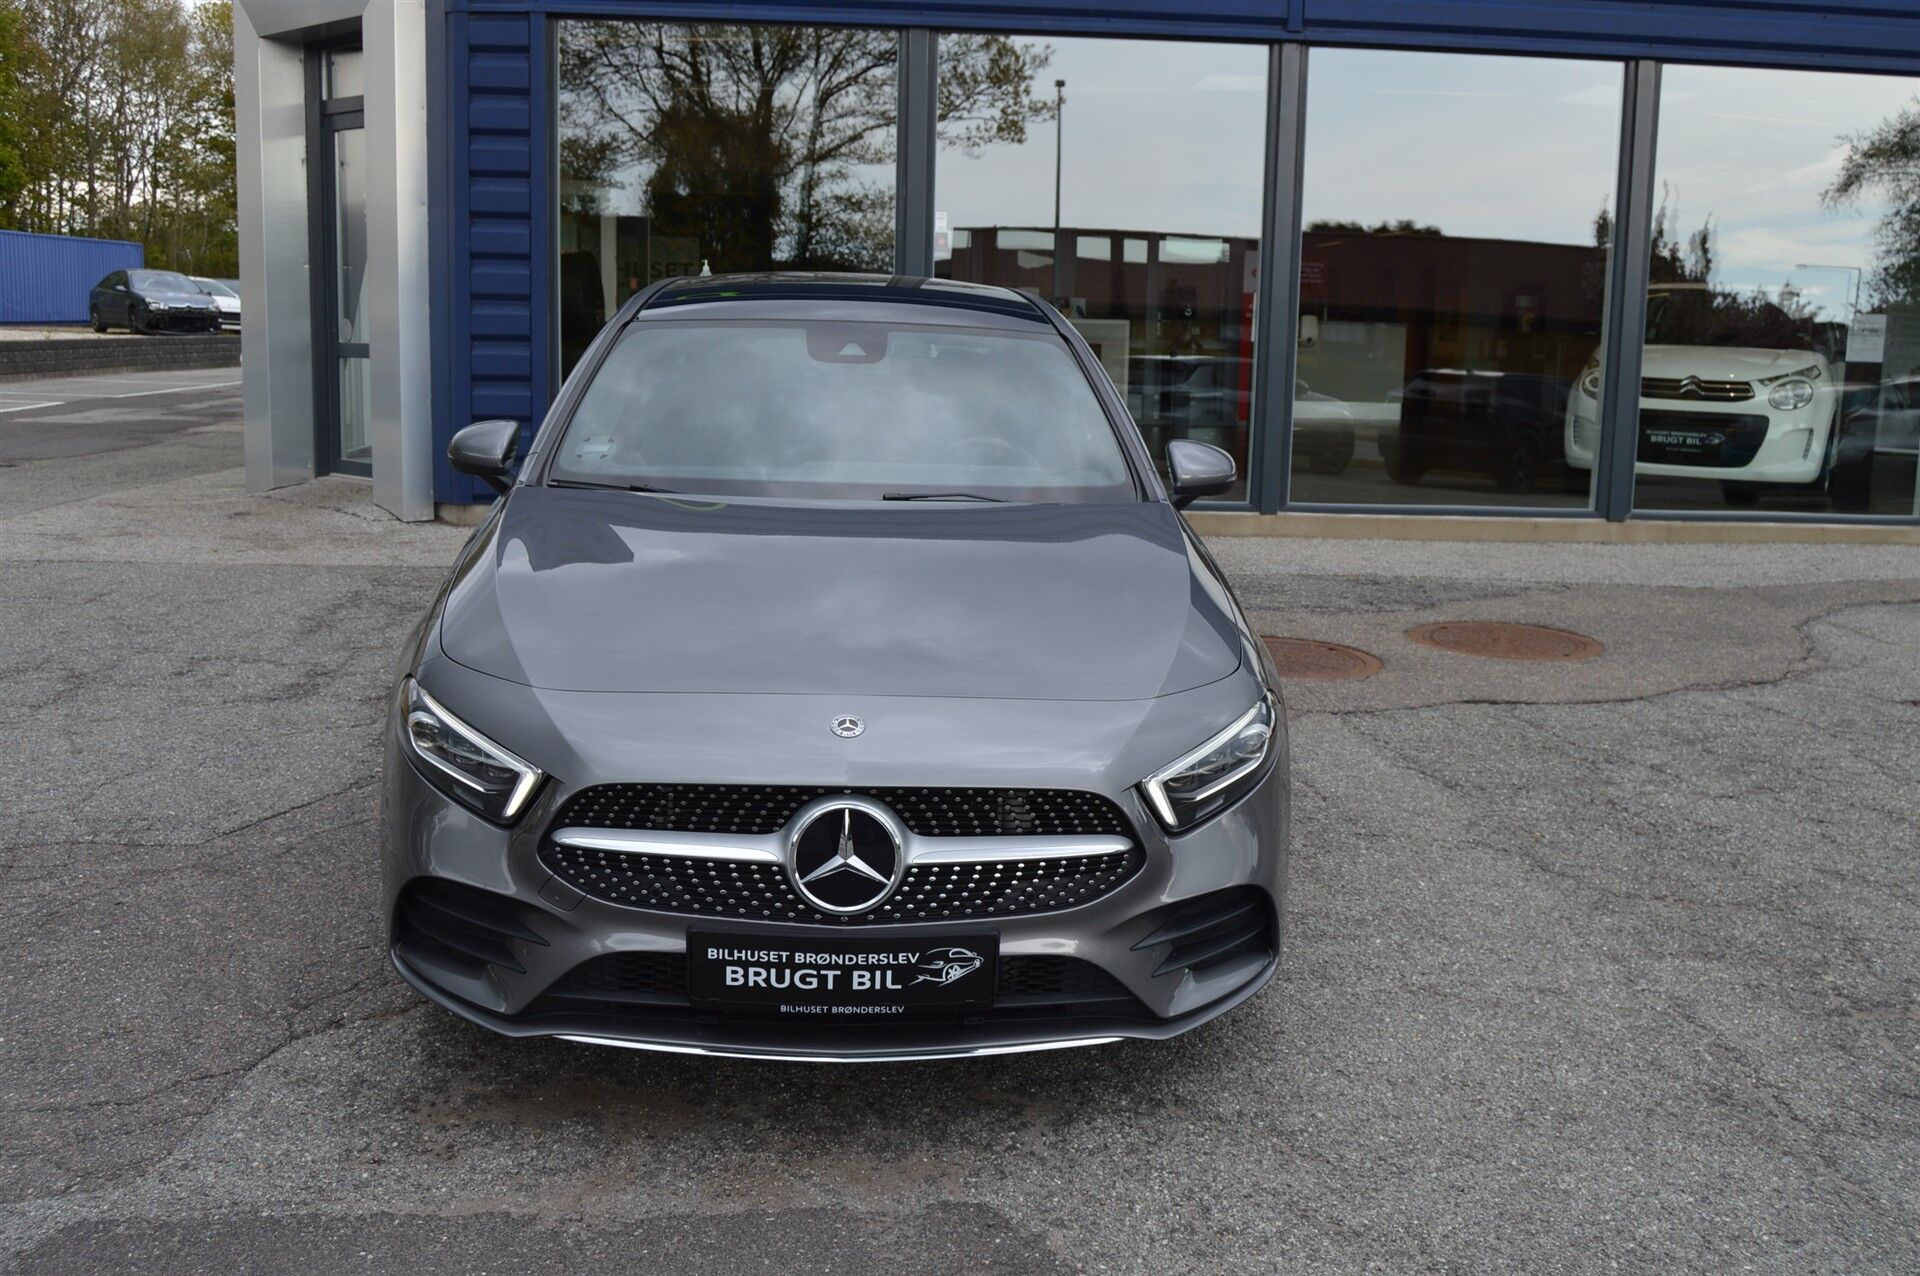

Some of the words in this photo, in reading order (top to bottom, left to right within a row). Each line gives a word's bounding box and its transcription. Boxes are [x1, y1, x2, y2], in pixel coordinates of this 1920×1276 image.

[1650, 435, 1684, 444] BRUGT
[1686, 437, 1702, 445] BIL
[707, 948, 790, 963] BILHUSET
[794, 952, 920, 965] BRØNDERSLEV
[725, 965, 841, 990] BRUGT
[852, 970, 902, 990] BIL
[780, 1004, 828, 1014] BILHUSET
[831, 1005, 905, 1014] BRØNDERSLEV
